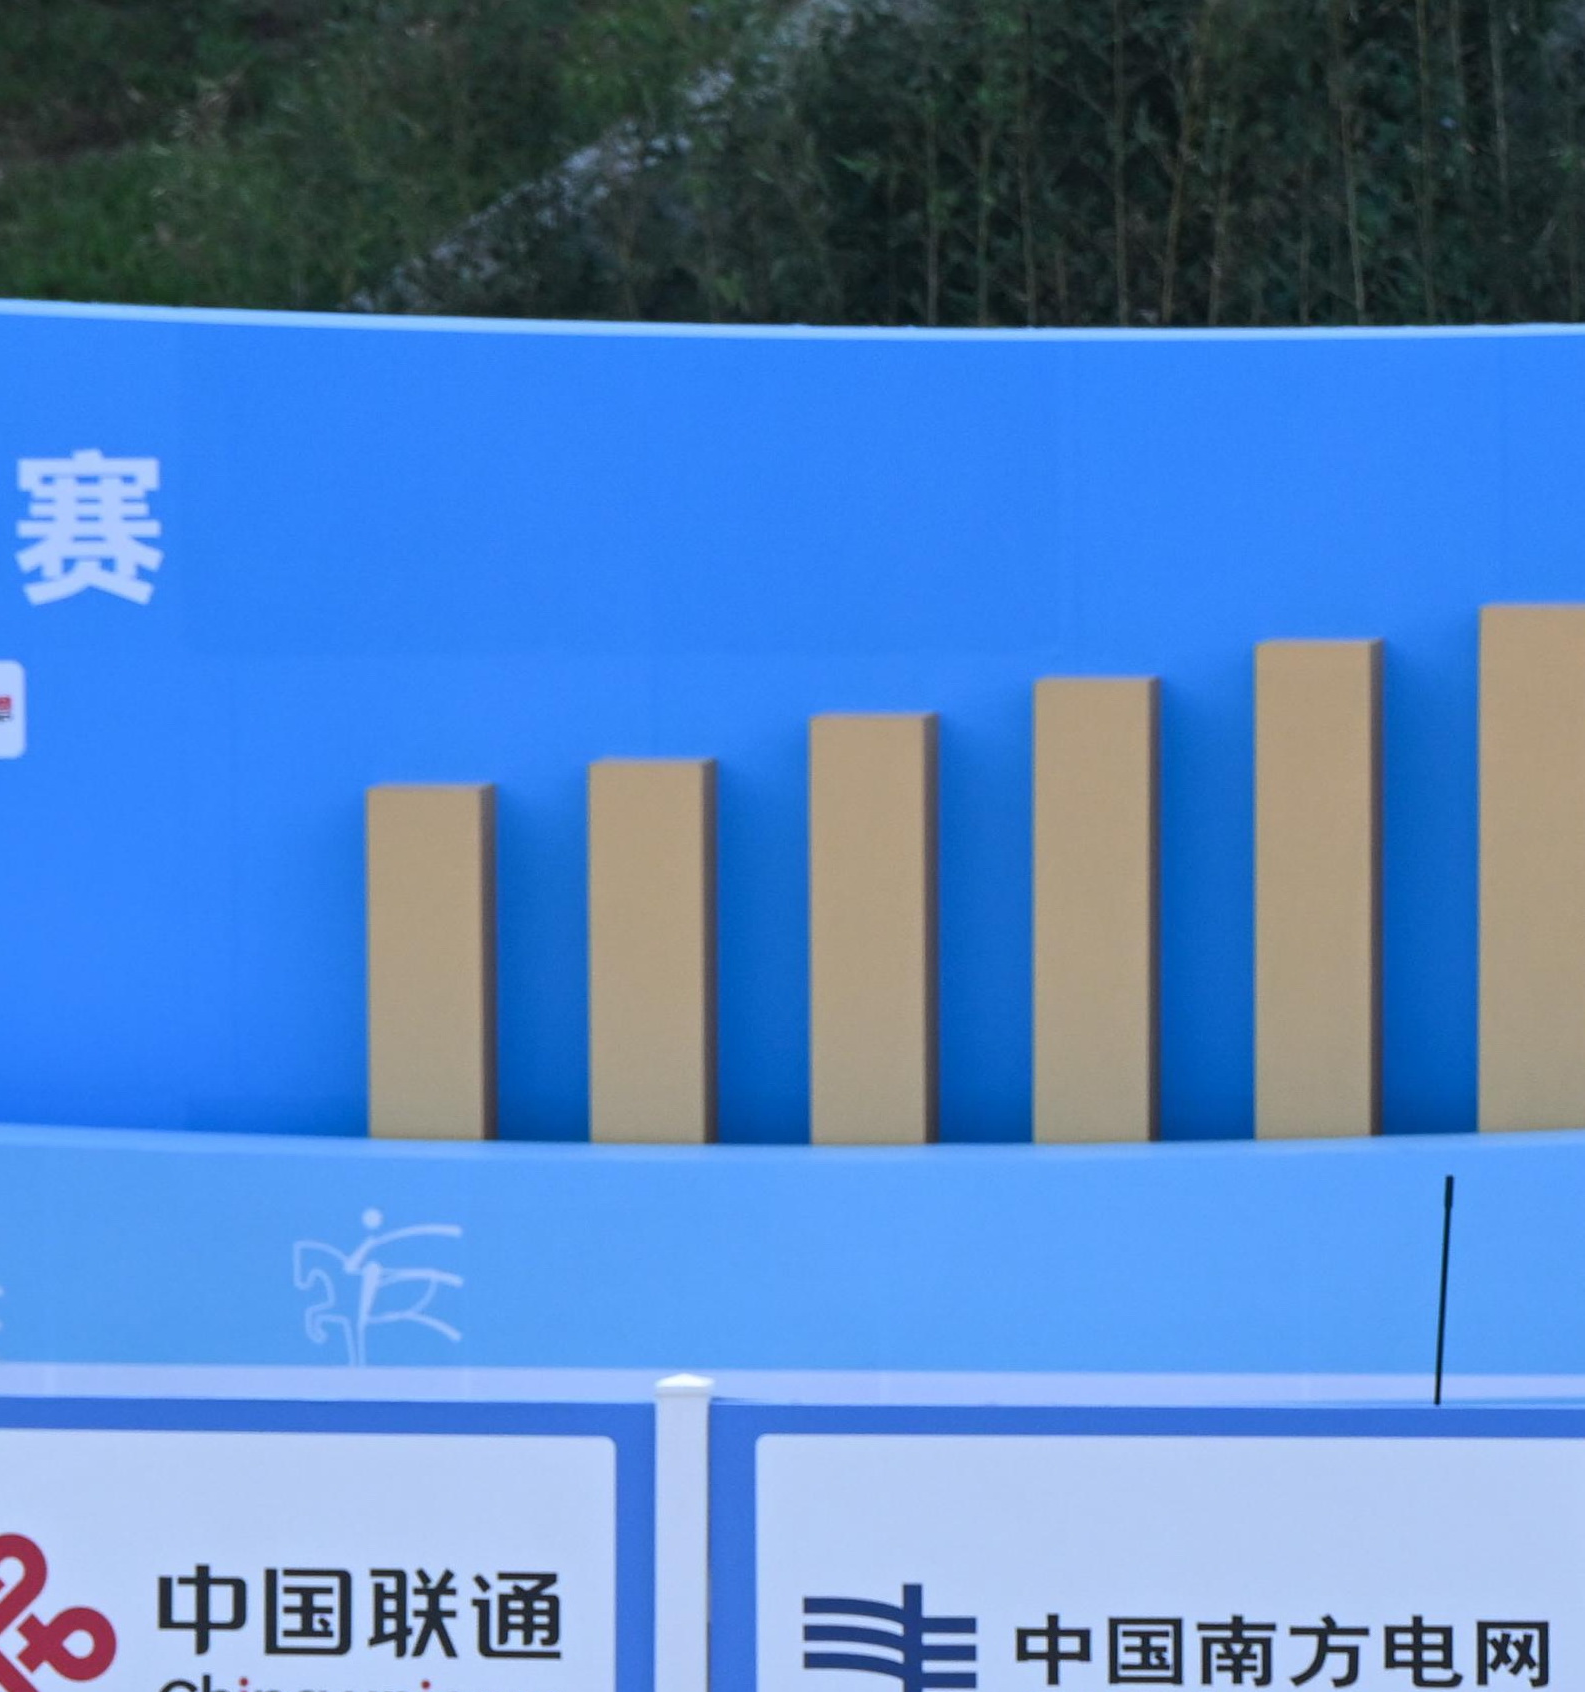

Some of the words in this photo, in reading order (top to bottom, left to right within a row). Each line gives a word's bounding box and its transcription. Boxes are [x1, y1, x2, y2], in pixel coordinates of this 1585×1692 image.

[157, 1563, 562, 1660] 中国联通
[1015, 1613, 1551, 1688] 中国南方电网
